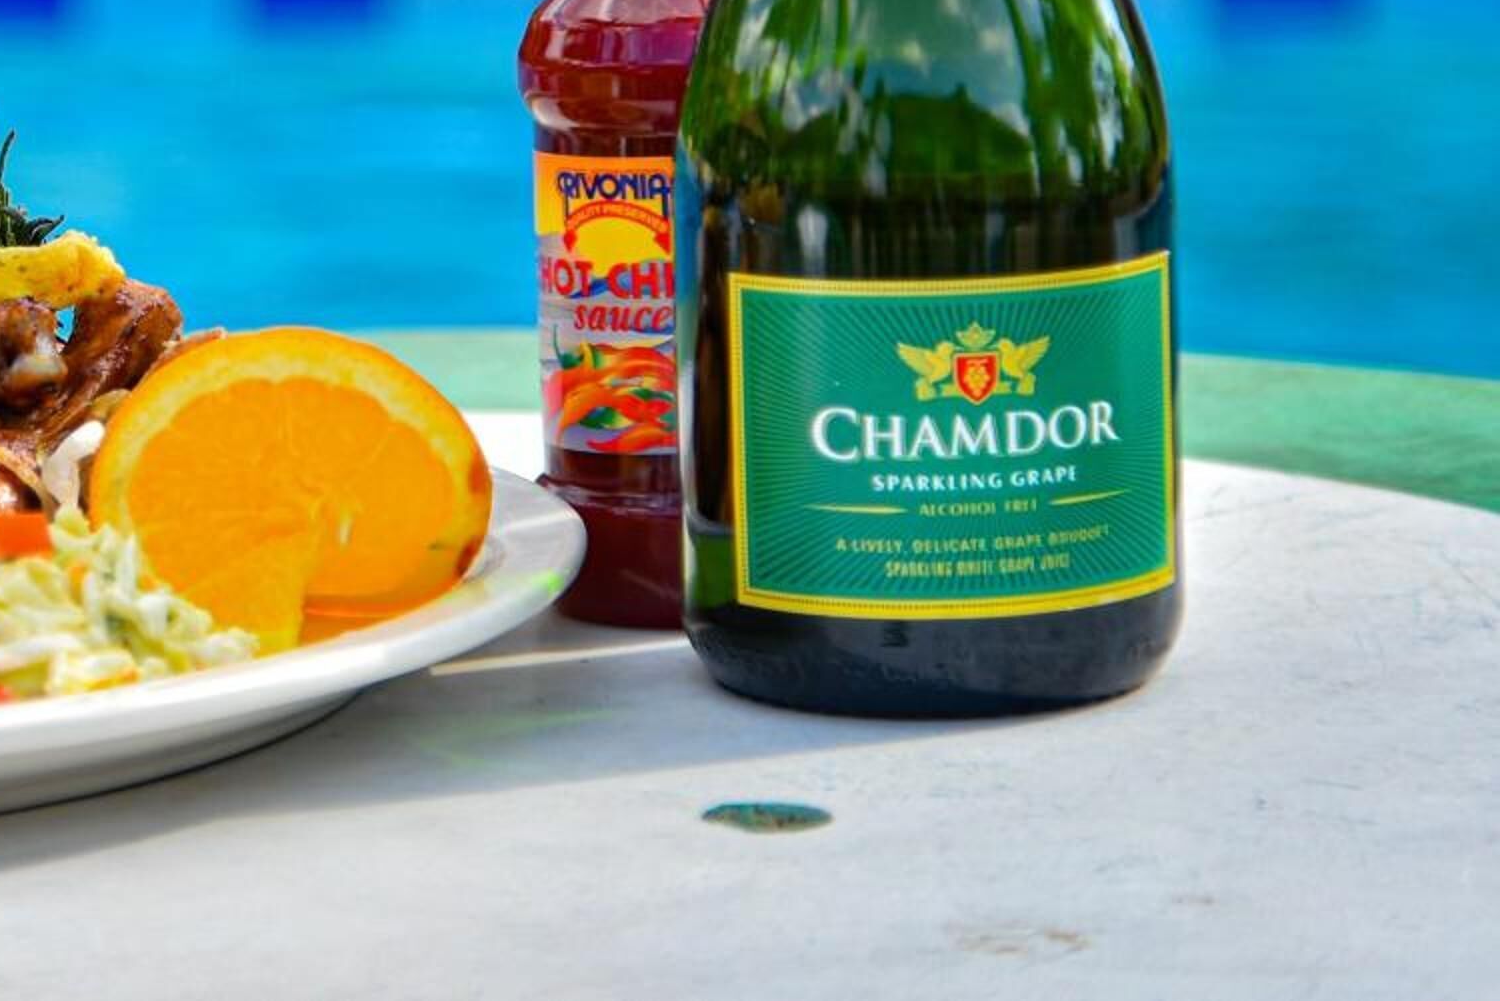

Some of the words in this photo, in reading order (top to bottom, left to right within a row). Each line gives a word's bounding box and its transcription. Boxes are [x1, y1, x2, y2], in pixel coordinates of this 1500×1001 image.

[558, 171, 671, 207] RIVONIA
[541, 258, 592, 297] HOT
[573, 305, 671, 332] sauce
[810, 400, 1120, 462] CHAMDOR
[872, 472, 1003, 492] SPARKLING
[1010, 465, 1077, 487] GRAPE
[919, 502, 996, 517] ALCOHOL
[835, 537, 847, 552] A
[912, 538, 986, 554] DELICATE
[995, 535, 1042, 552] GRAPE
